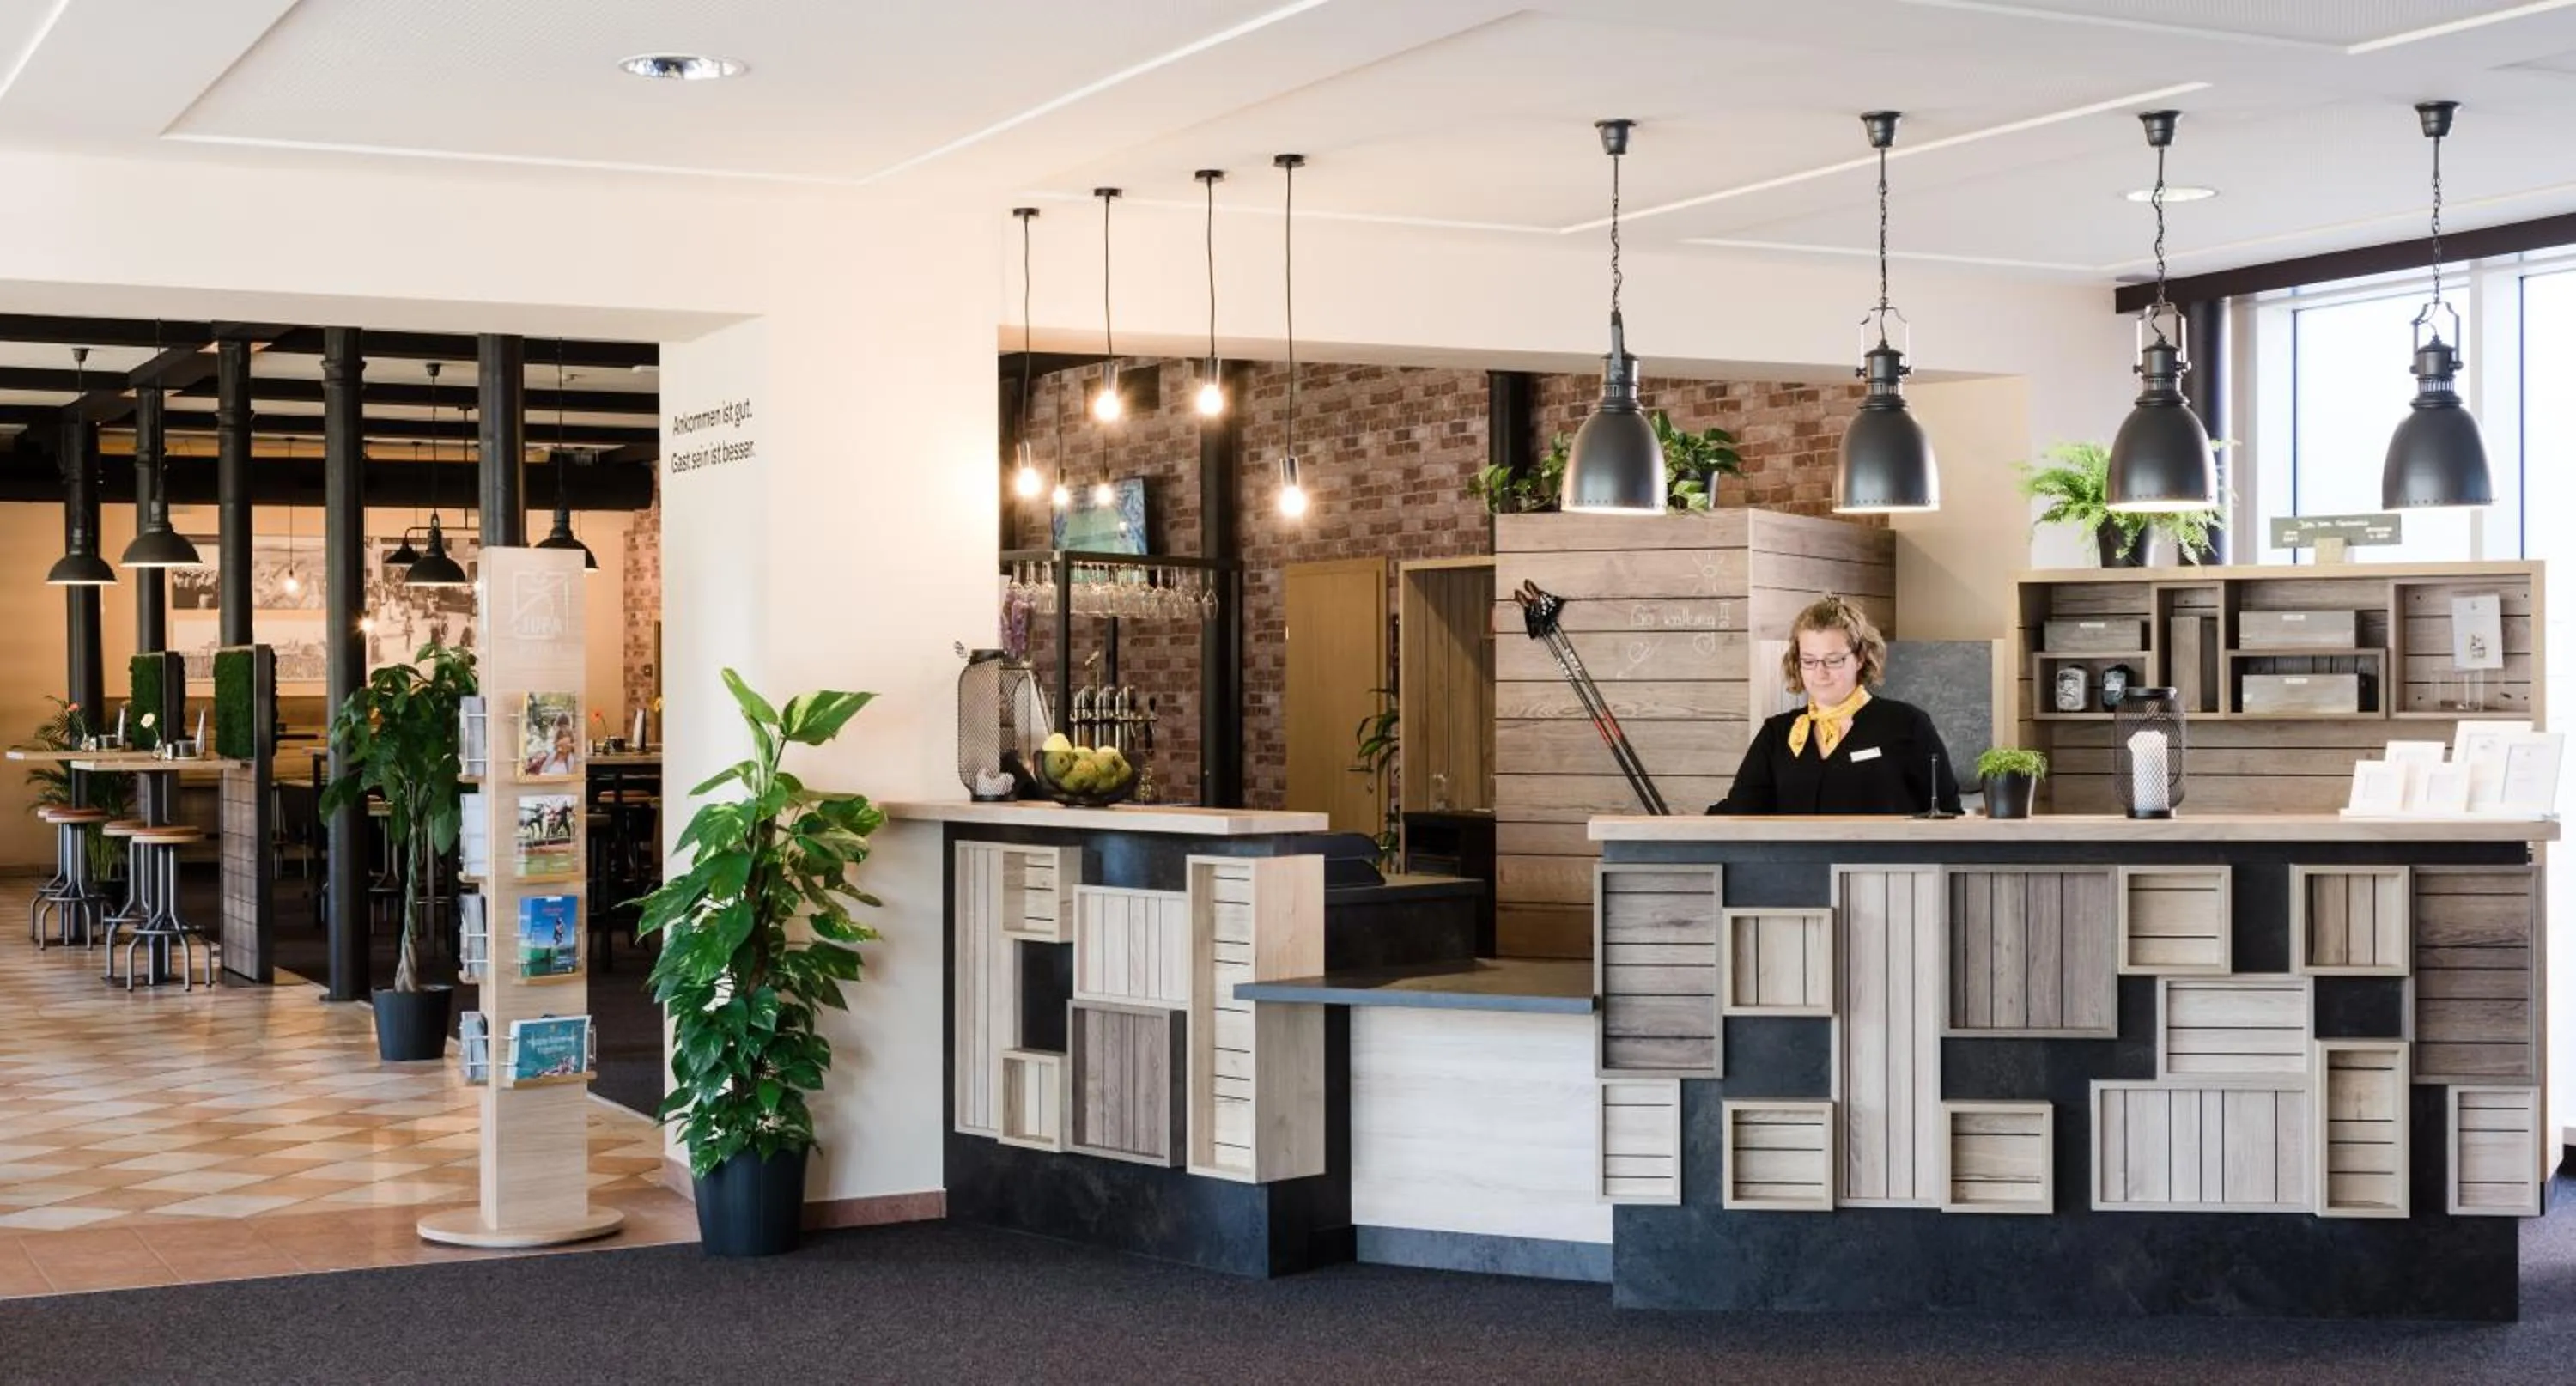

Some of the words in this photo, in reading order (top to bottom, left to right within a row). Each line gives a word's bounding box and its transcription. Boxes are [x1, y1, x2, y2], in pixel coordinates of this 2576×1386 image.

[672, 409, 721, 435] Ankommen
[722, 399, 733, 423] ist
[734, 398, 753, 428] gut.
[671, 452, 690, 473] Gast
[691, 445, 709, 469] sein
[710, 441, 721, 465] ist
